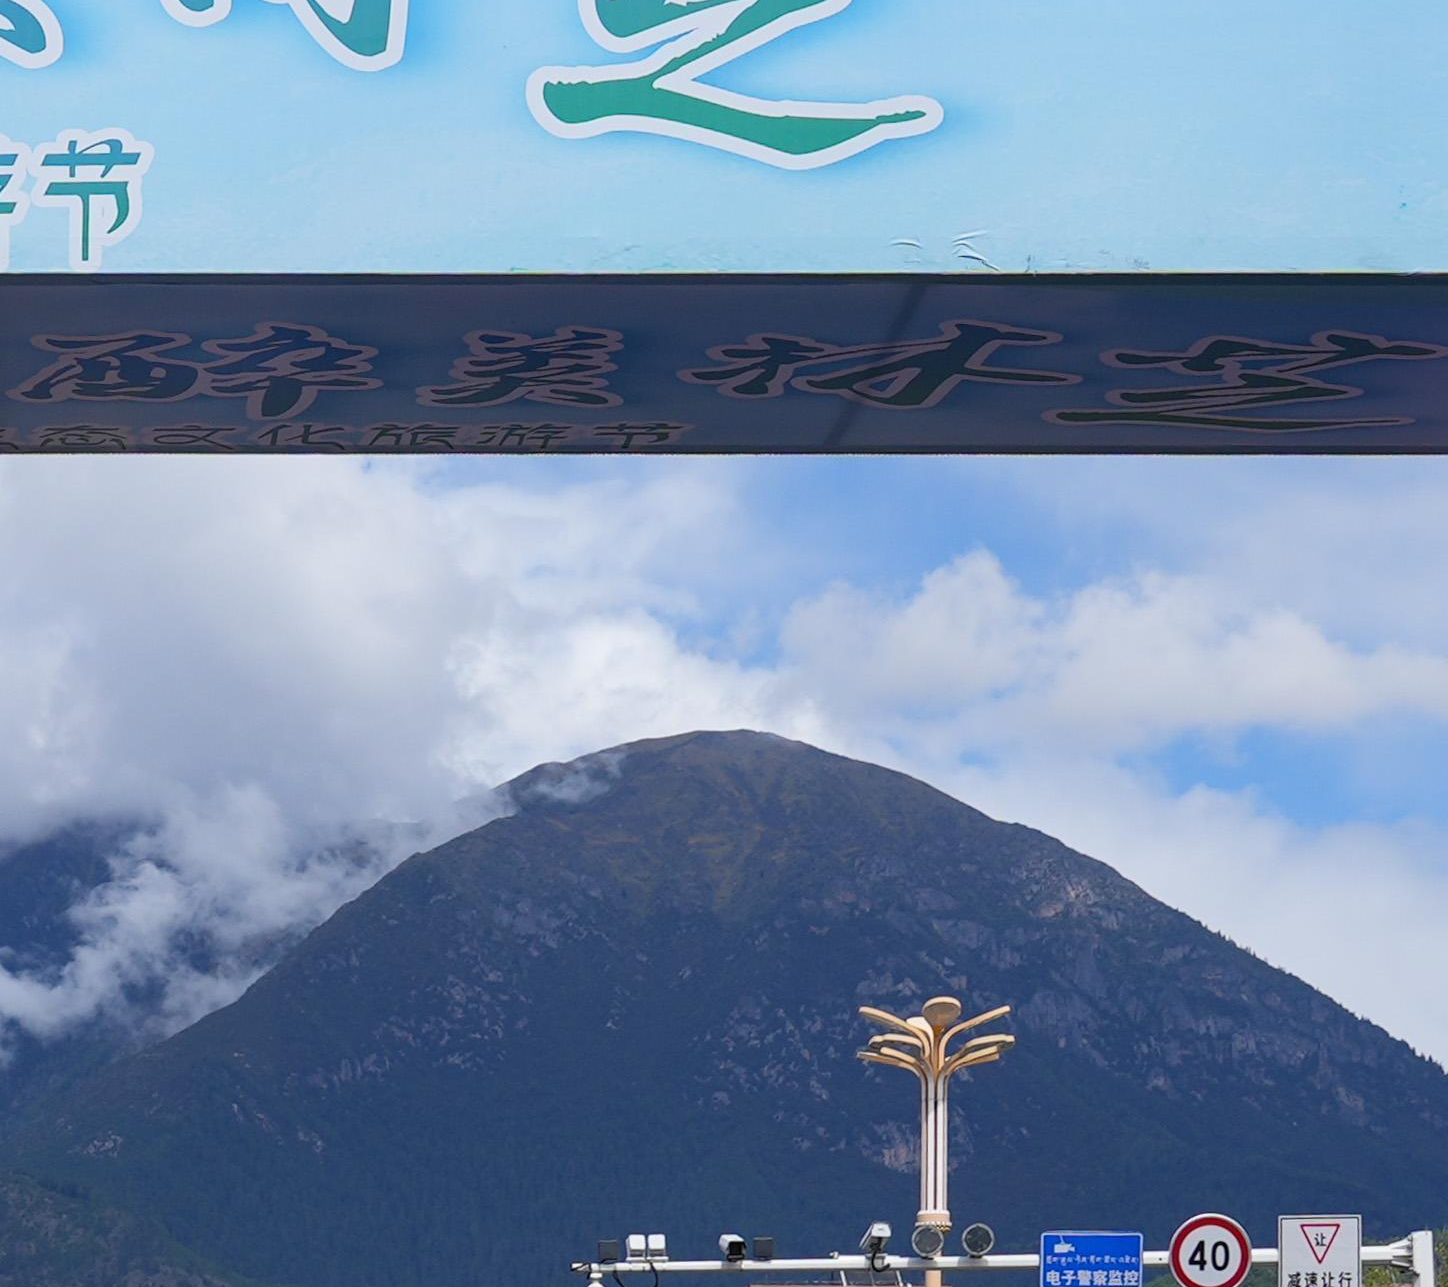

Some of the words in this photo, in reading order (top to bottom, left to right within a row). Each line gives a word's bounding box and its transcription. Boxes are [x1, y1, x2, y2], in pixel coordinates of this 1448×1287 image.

[16, 321, 1446, 432] 醉美林芝
[1313, 1233, 1327, 1248] 让
[1188, 1240, 1230, 1272] 40
[1046, 1269, 1139, 1287] 电子警察监控
